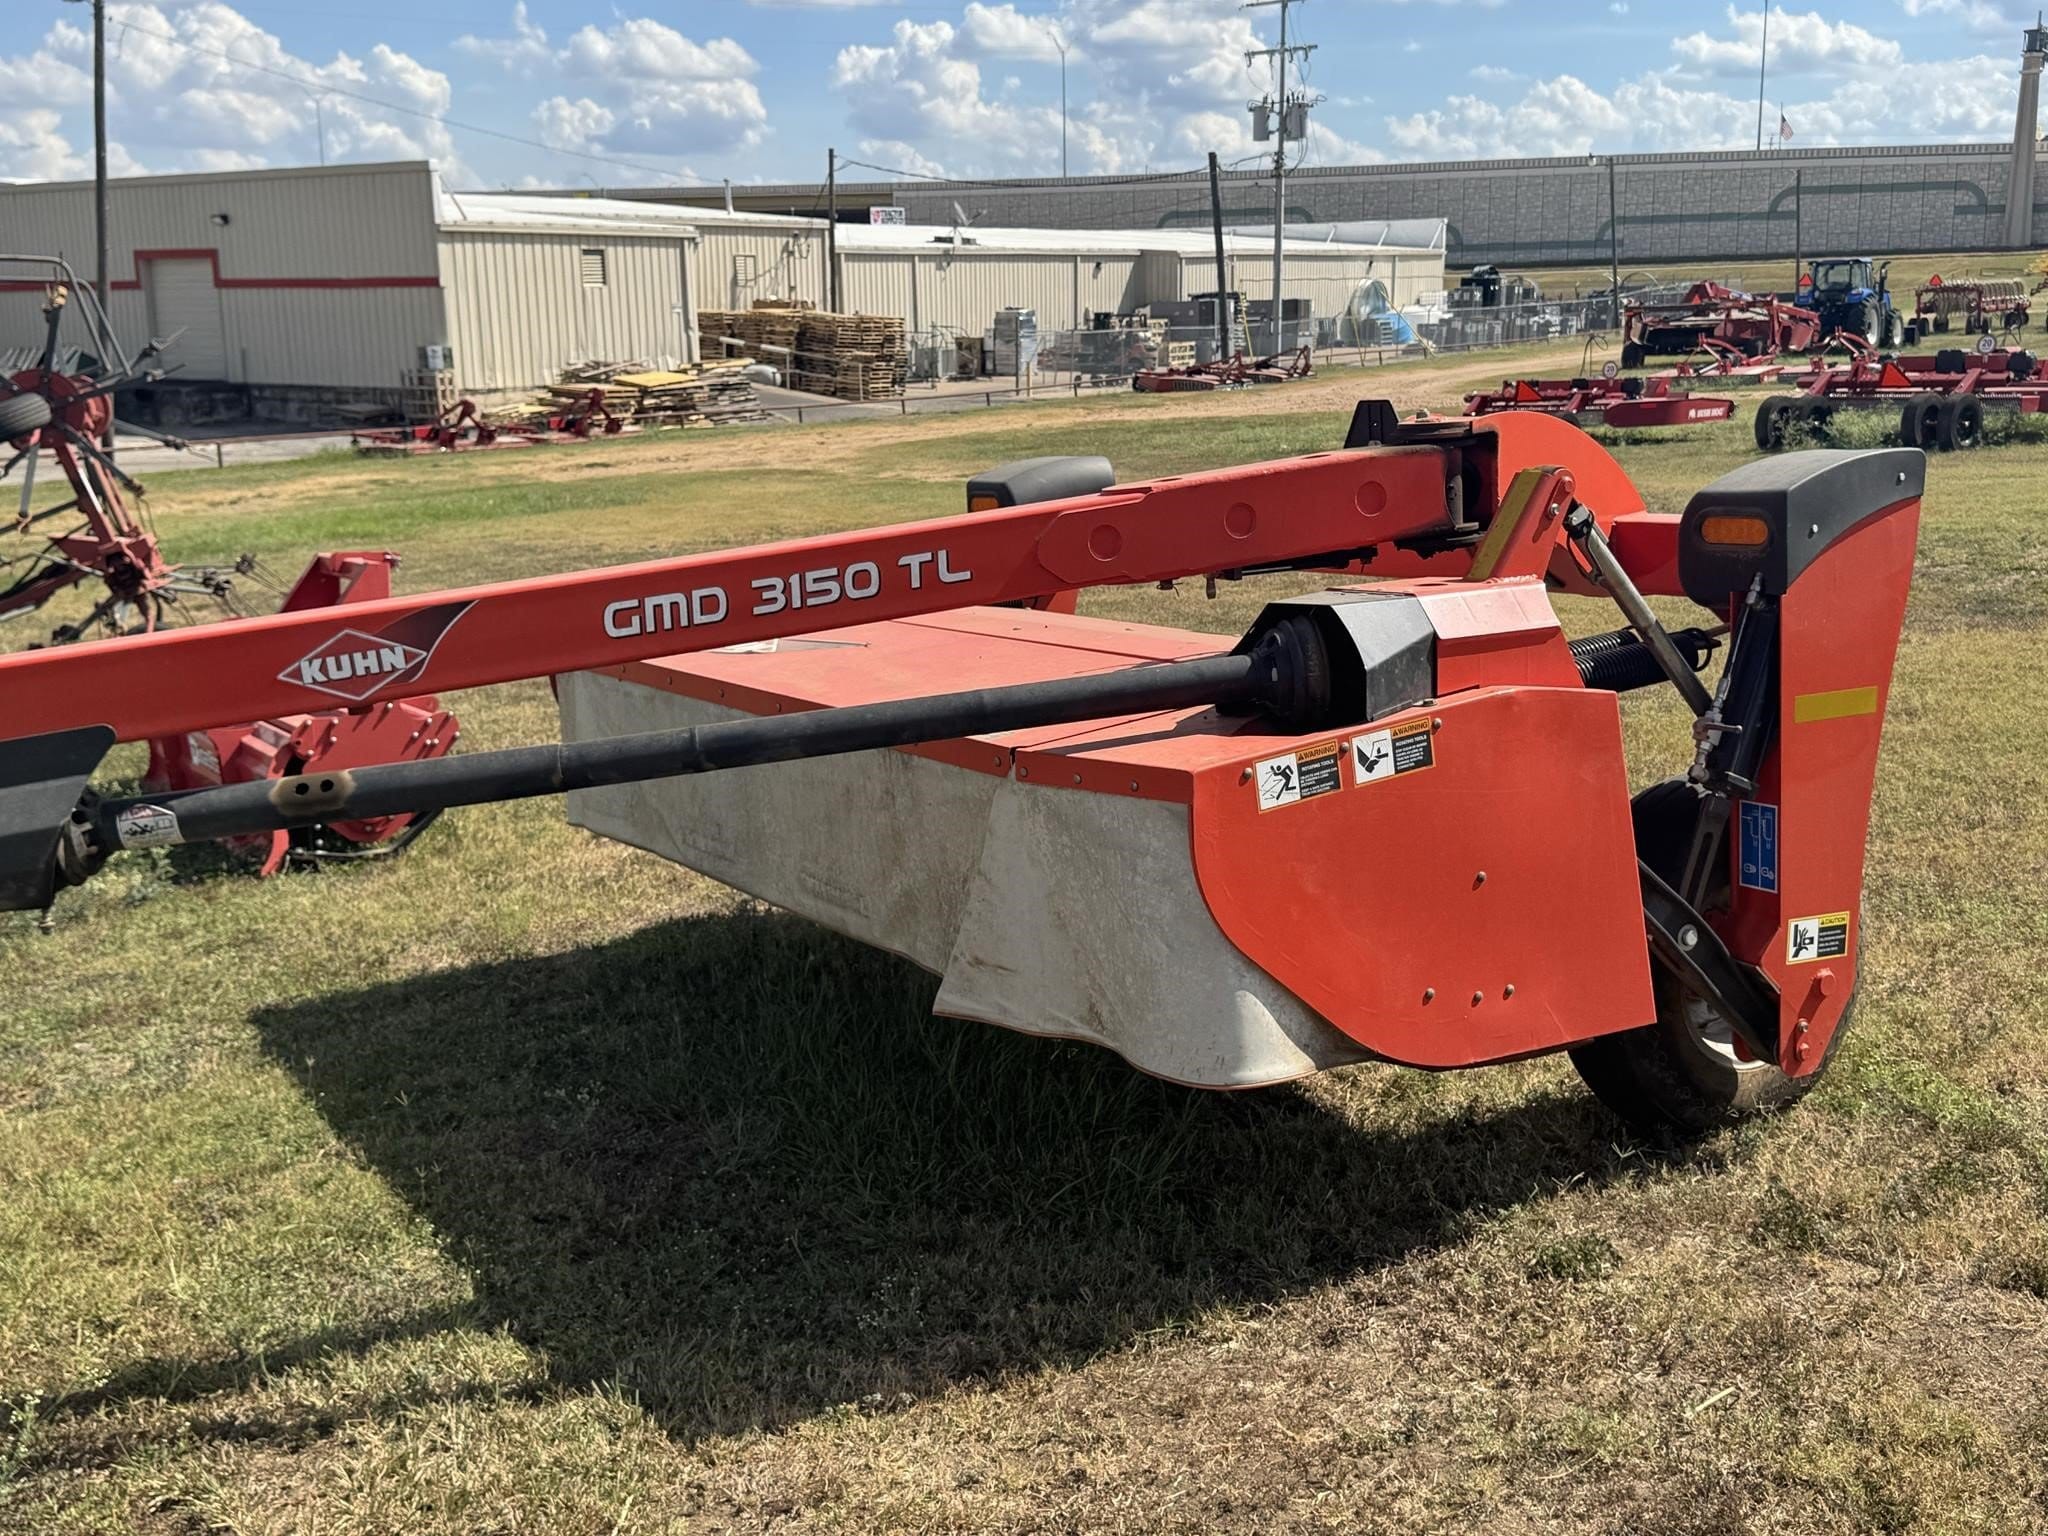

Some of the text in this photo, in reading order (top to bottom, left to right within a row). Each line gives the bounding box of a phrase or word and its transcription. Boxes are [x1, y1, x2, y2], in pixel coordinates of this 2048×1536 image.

[604, 549, 972, 638] GMD 3150 TL
[300, 645, 407, 684] KUHN
[1399, 721, 1429, 735] WARNING
[1304, 745, 1335, 759] WARNING
